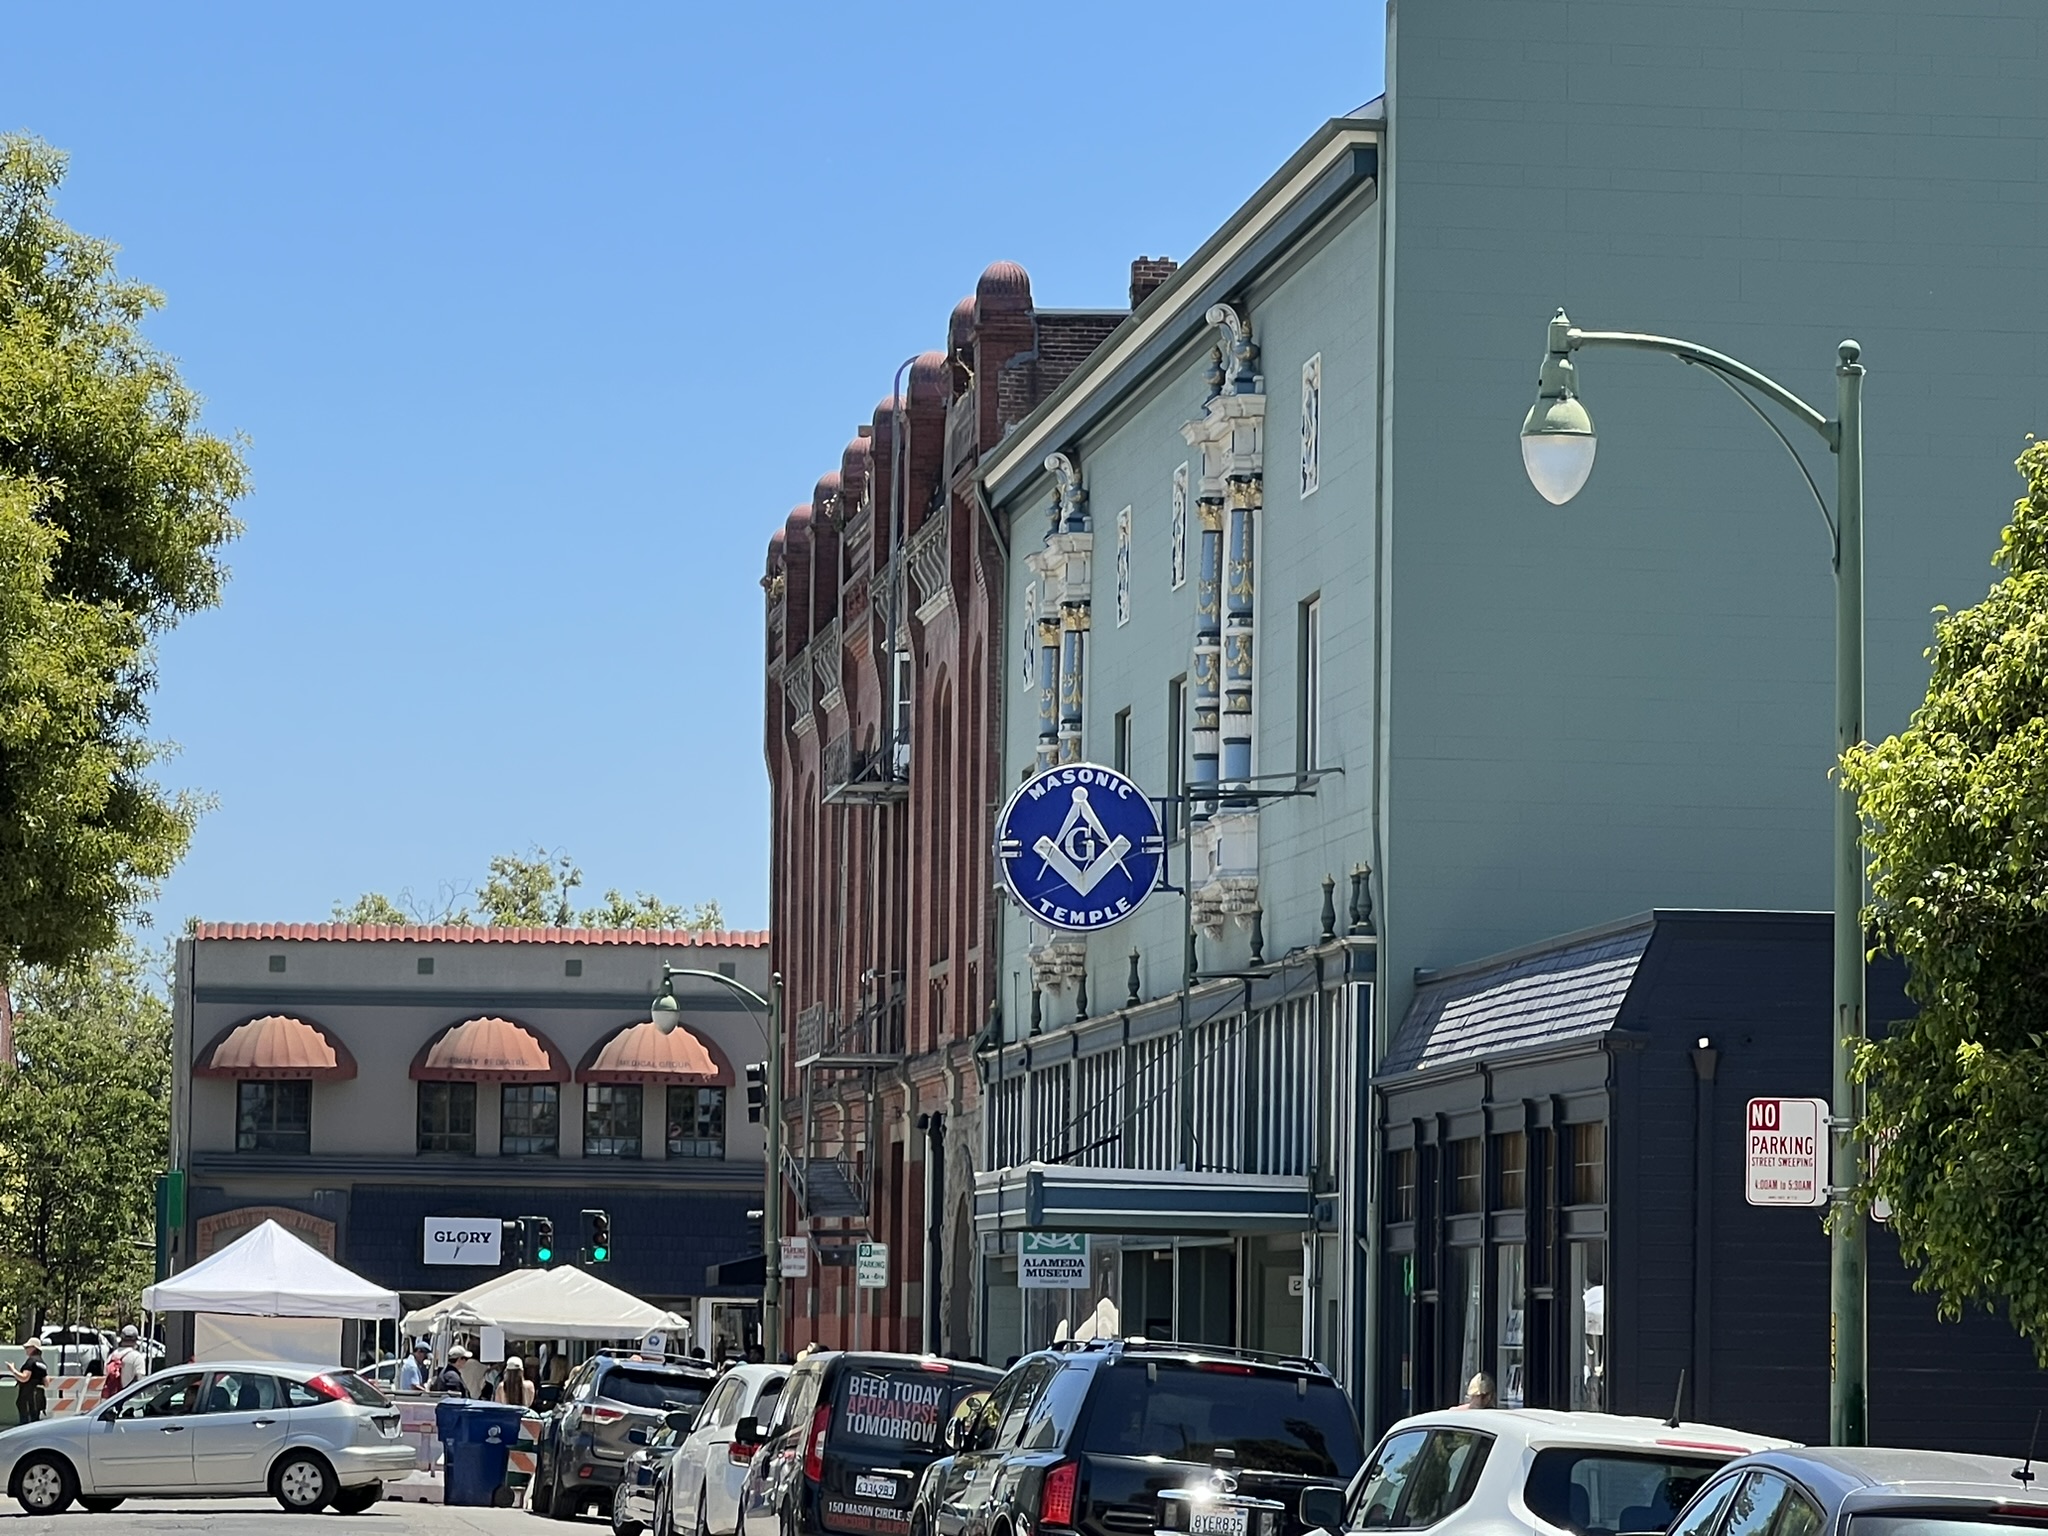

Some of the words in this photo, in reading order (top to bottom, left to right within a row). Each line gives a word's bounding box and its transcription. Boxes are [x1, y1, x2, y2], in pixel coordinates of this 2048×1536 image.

[1027, 769, 1132, 801] MASONIC
[1065, 825, 1095, 861] G
[1040, 897, 1132, 924] TEMPLE
[1752, 1103, 1776, 1127] NO
[1752, 1136, 1813, 1156] PARKING
[1752, 1157, 1776, 1167] STREET
[1778, 1157, 1813, 1168] SWEEPING
[434, 1231, 492, 1244] GLORY
[860, 1260, 885, 1269] PARKING
[1023, 1258, 1086, 1268] ALAMEDA
[1025, 1268, 1083, 1278] MUSEUM
[848, 1376, 889, 1399] BEER
[894, 1381, 943, 1406] TODAY
[846, 1395, 940, 1424] APOCALYPSE
[845, 1412, 938, 1443] TOMORROW
[828, 1501, 844, 1513] 150
[844, 1503, 874, 1517] MASON
[875, 1518, 908, 1534] CALIFO
[1194, 1515, 1243, 1532] 8YER835
